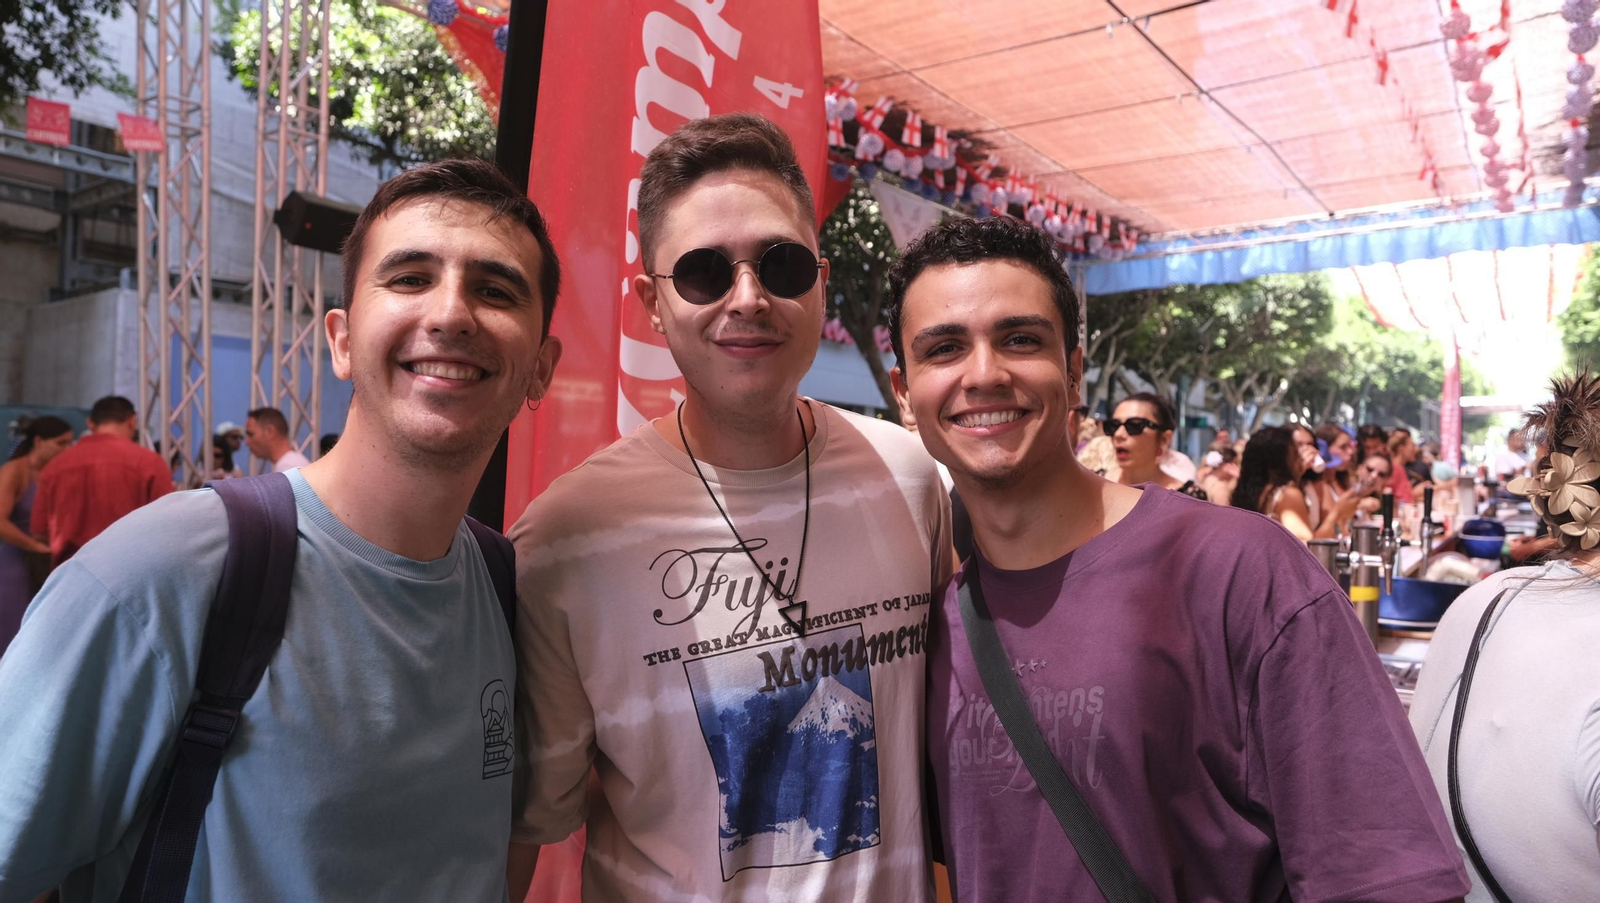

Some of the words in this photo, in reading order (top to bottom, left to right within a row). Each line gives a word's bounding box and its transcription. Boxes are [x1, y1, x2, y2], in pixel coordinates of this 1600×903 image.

[649, 538, 796, 640] Fuji
[643, 647, 682, 667] THE
[687, 631, 749, 656] GREAT
[755, 602, 878, 641] MAGIFICIENT
[882, 596, 901, 612] OF
[756, 612, 928, 693] Monument
